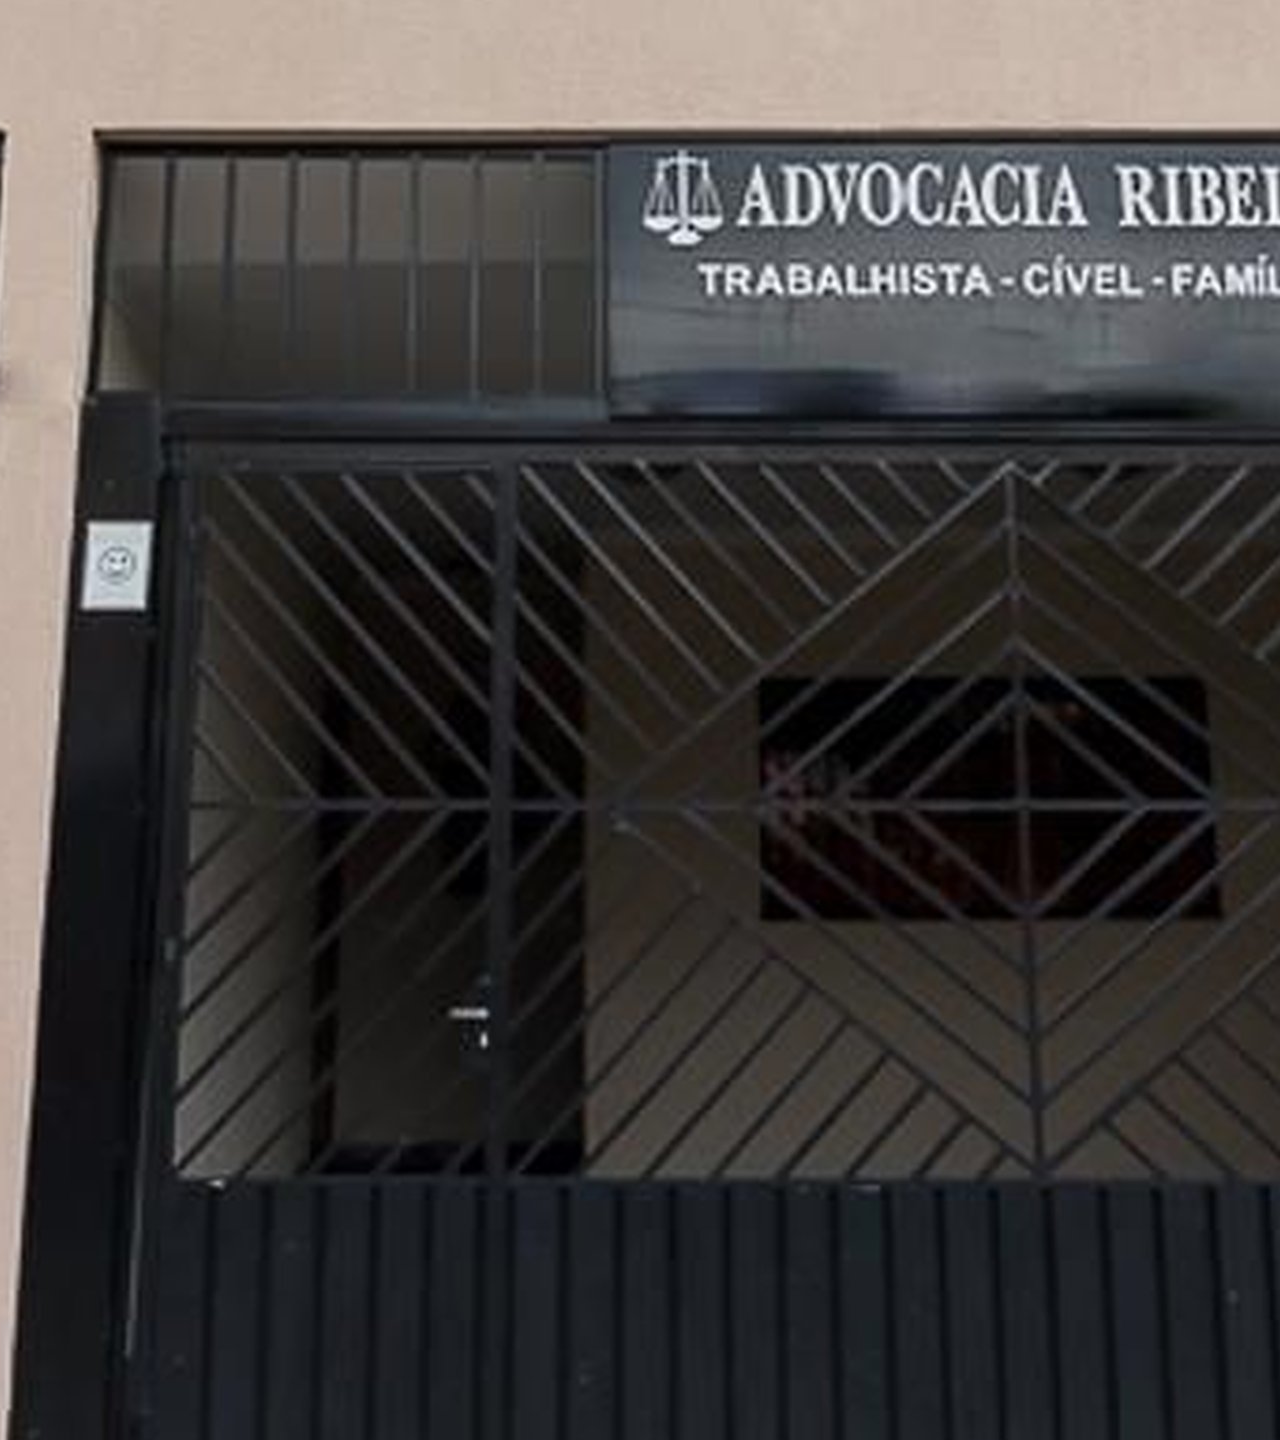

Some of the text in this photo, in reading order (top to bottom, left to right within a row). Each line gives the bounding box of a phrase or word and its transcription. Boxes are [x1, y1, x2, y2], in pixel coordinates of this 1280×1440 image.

[736, 161, 1088, 228] ADVOCACIA
[696, 262, 992, 297] TRABALHISTA
[1022, 253, 1145, 298] CÍVEL
